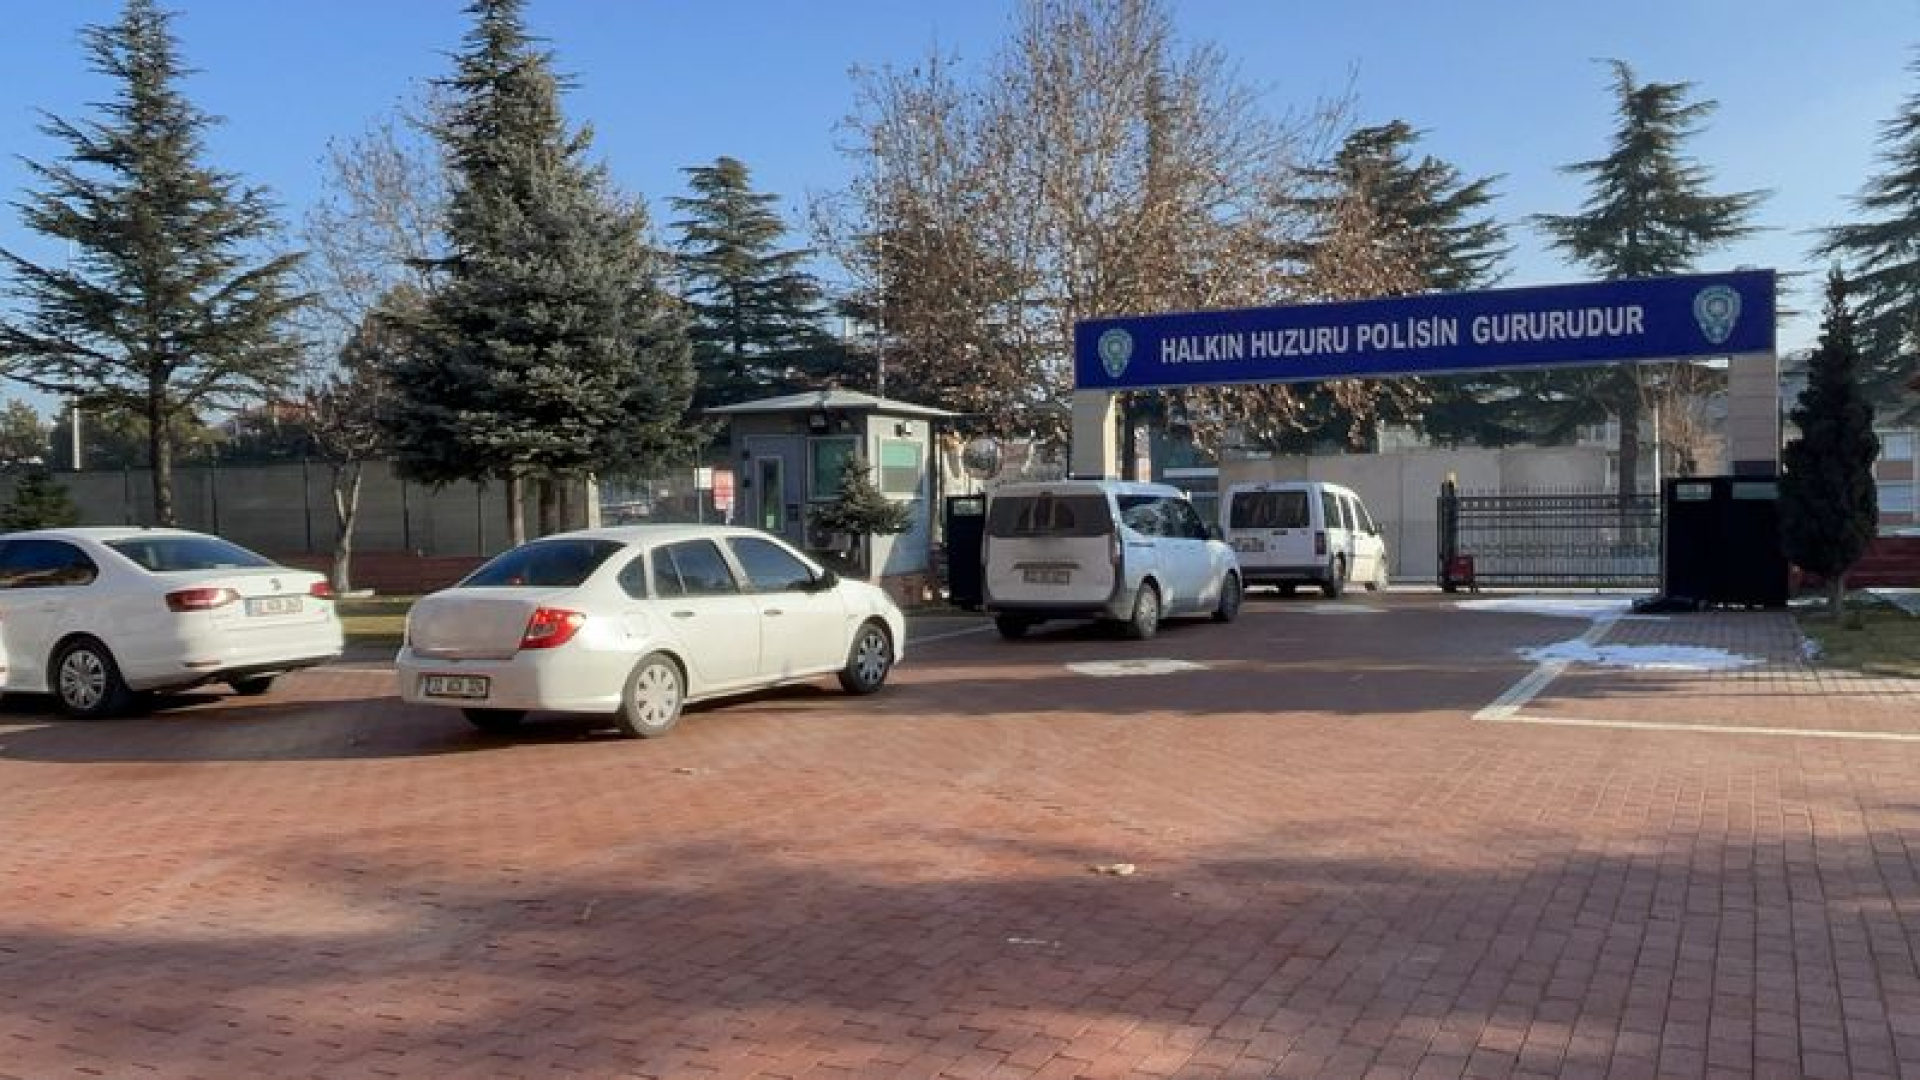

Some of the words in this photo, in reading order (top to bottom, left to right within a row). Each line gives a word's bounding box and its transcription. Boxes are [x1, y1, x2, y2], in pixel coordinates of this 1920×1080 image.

[1162, 333, 1243, 363] HALKIN
[1251, 326, 1349, 358] HUZURU
[1472, 305, 1644, 344] GURURUDUR
